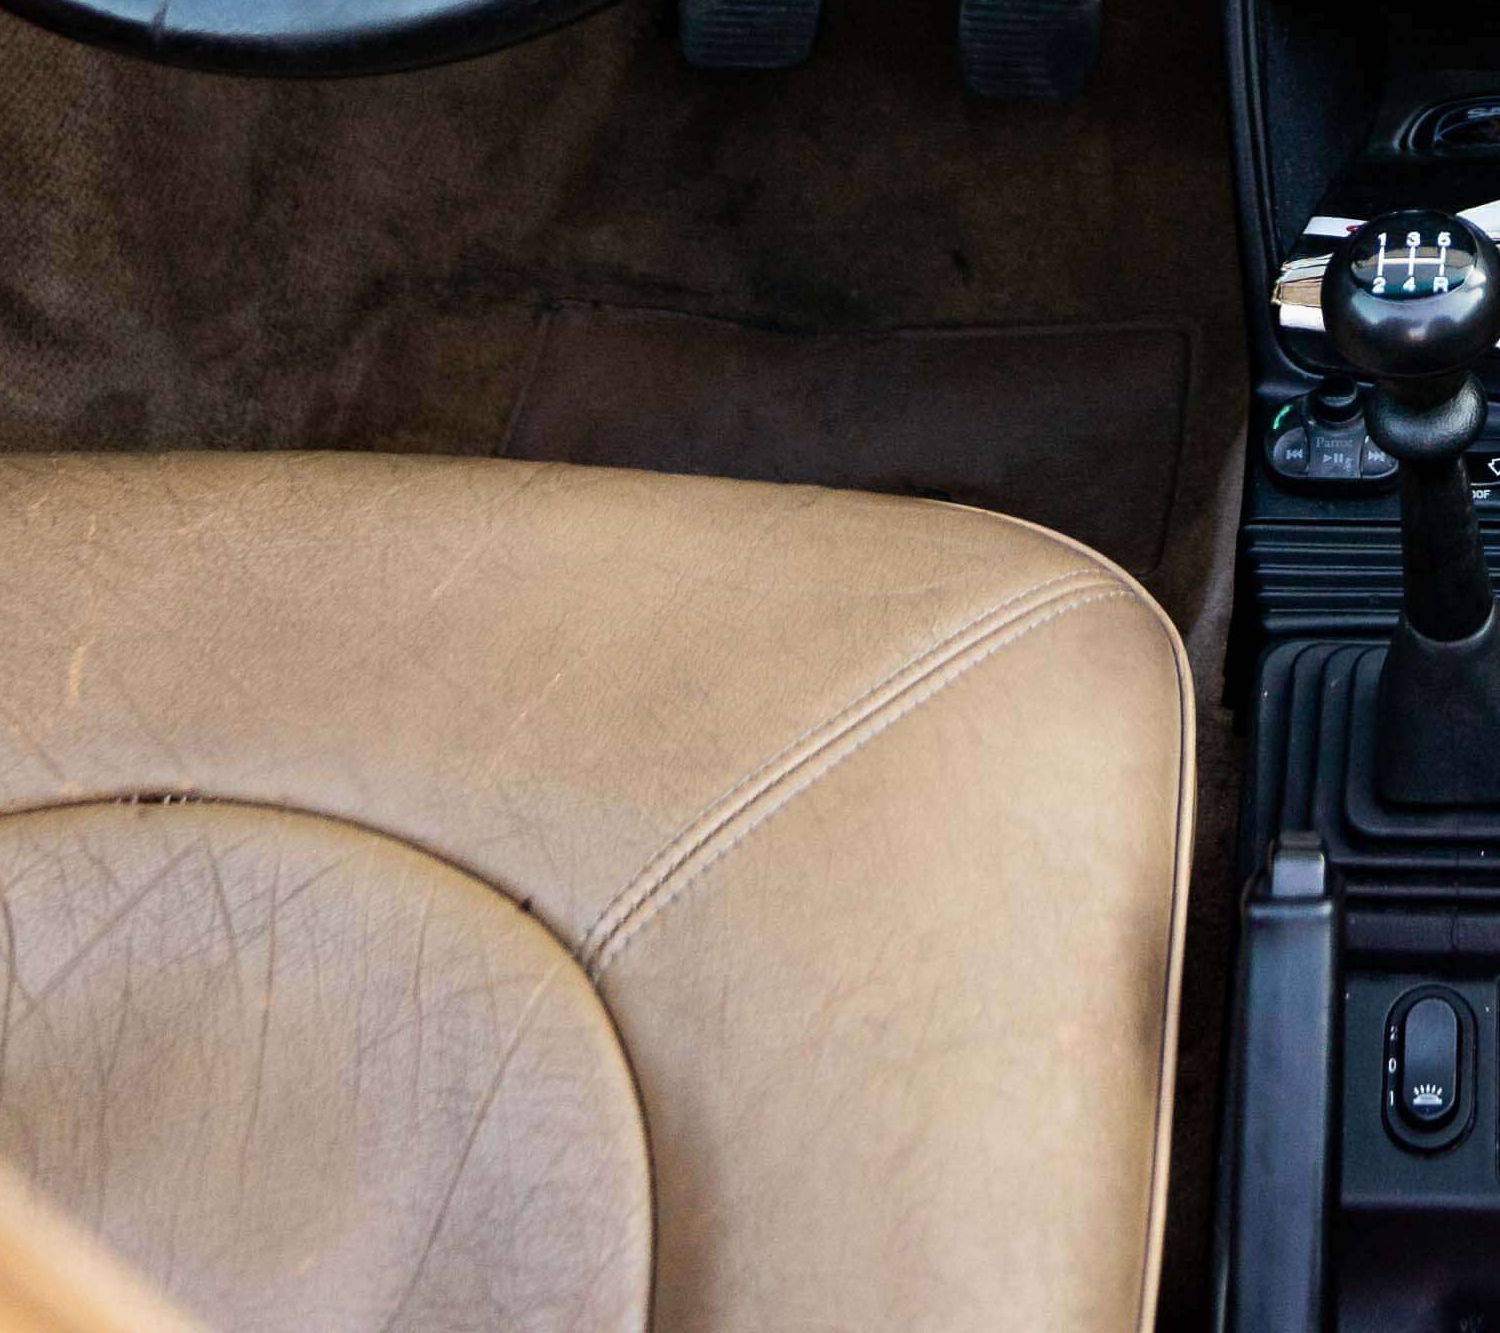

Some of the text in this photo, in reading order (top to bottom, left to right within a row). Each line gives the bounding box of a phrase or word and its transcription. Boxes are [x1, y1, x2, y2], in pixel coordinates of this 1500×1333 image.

[1377, 232, 1387, 247] 1
[1406, 231, 1421, 247] 3
[1372, 276, 1386, 294] 2
[1402, 276, 1416, 292] 4
[1433, 276, 1449, 294] R
[1388, 1057, 1397, 1075] 0
[1388, 1090, 1395, 1107] 1
